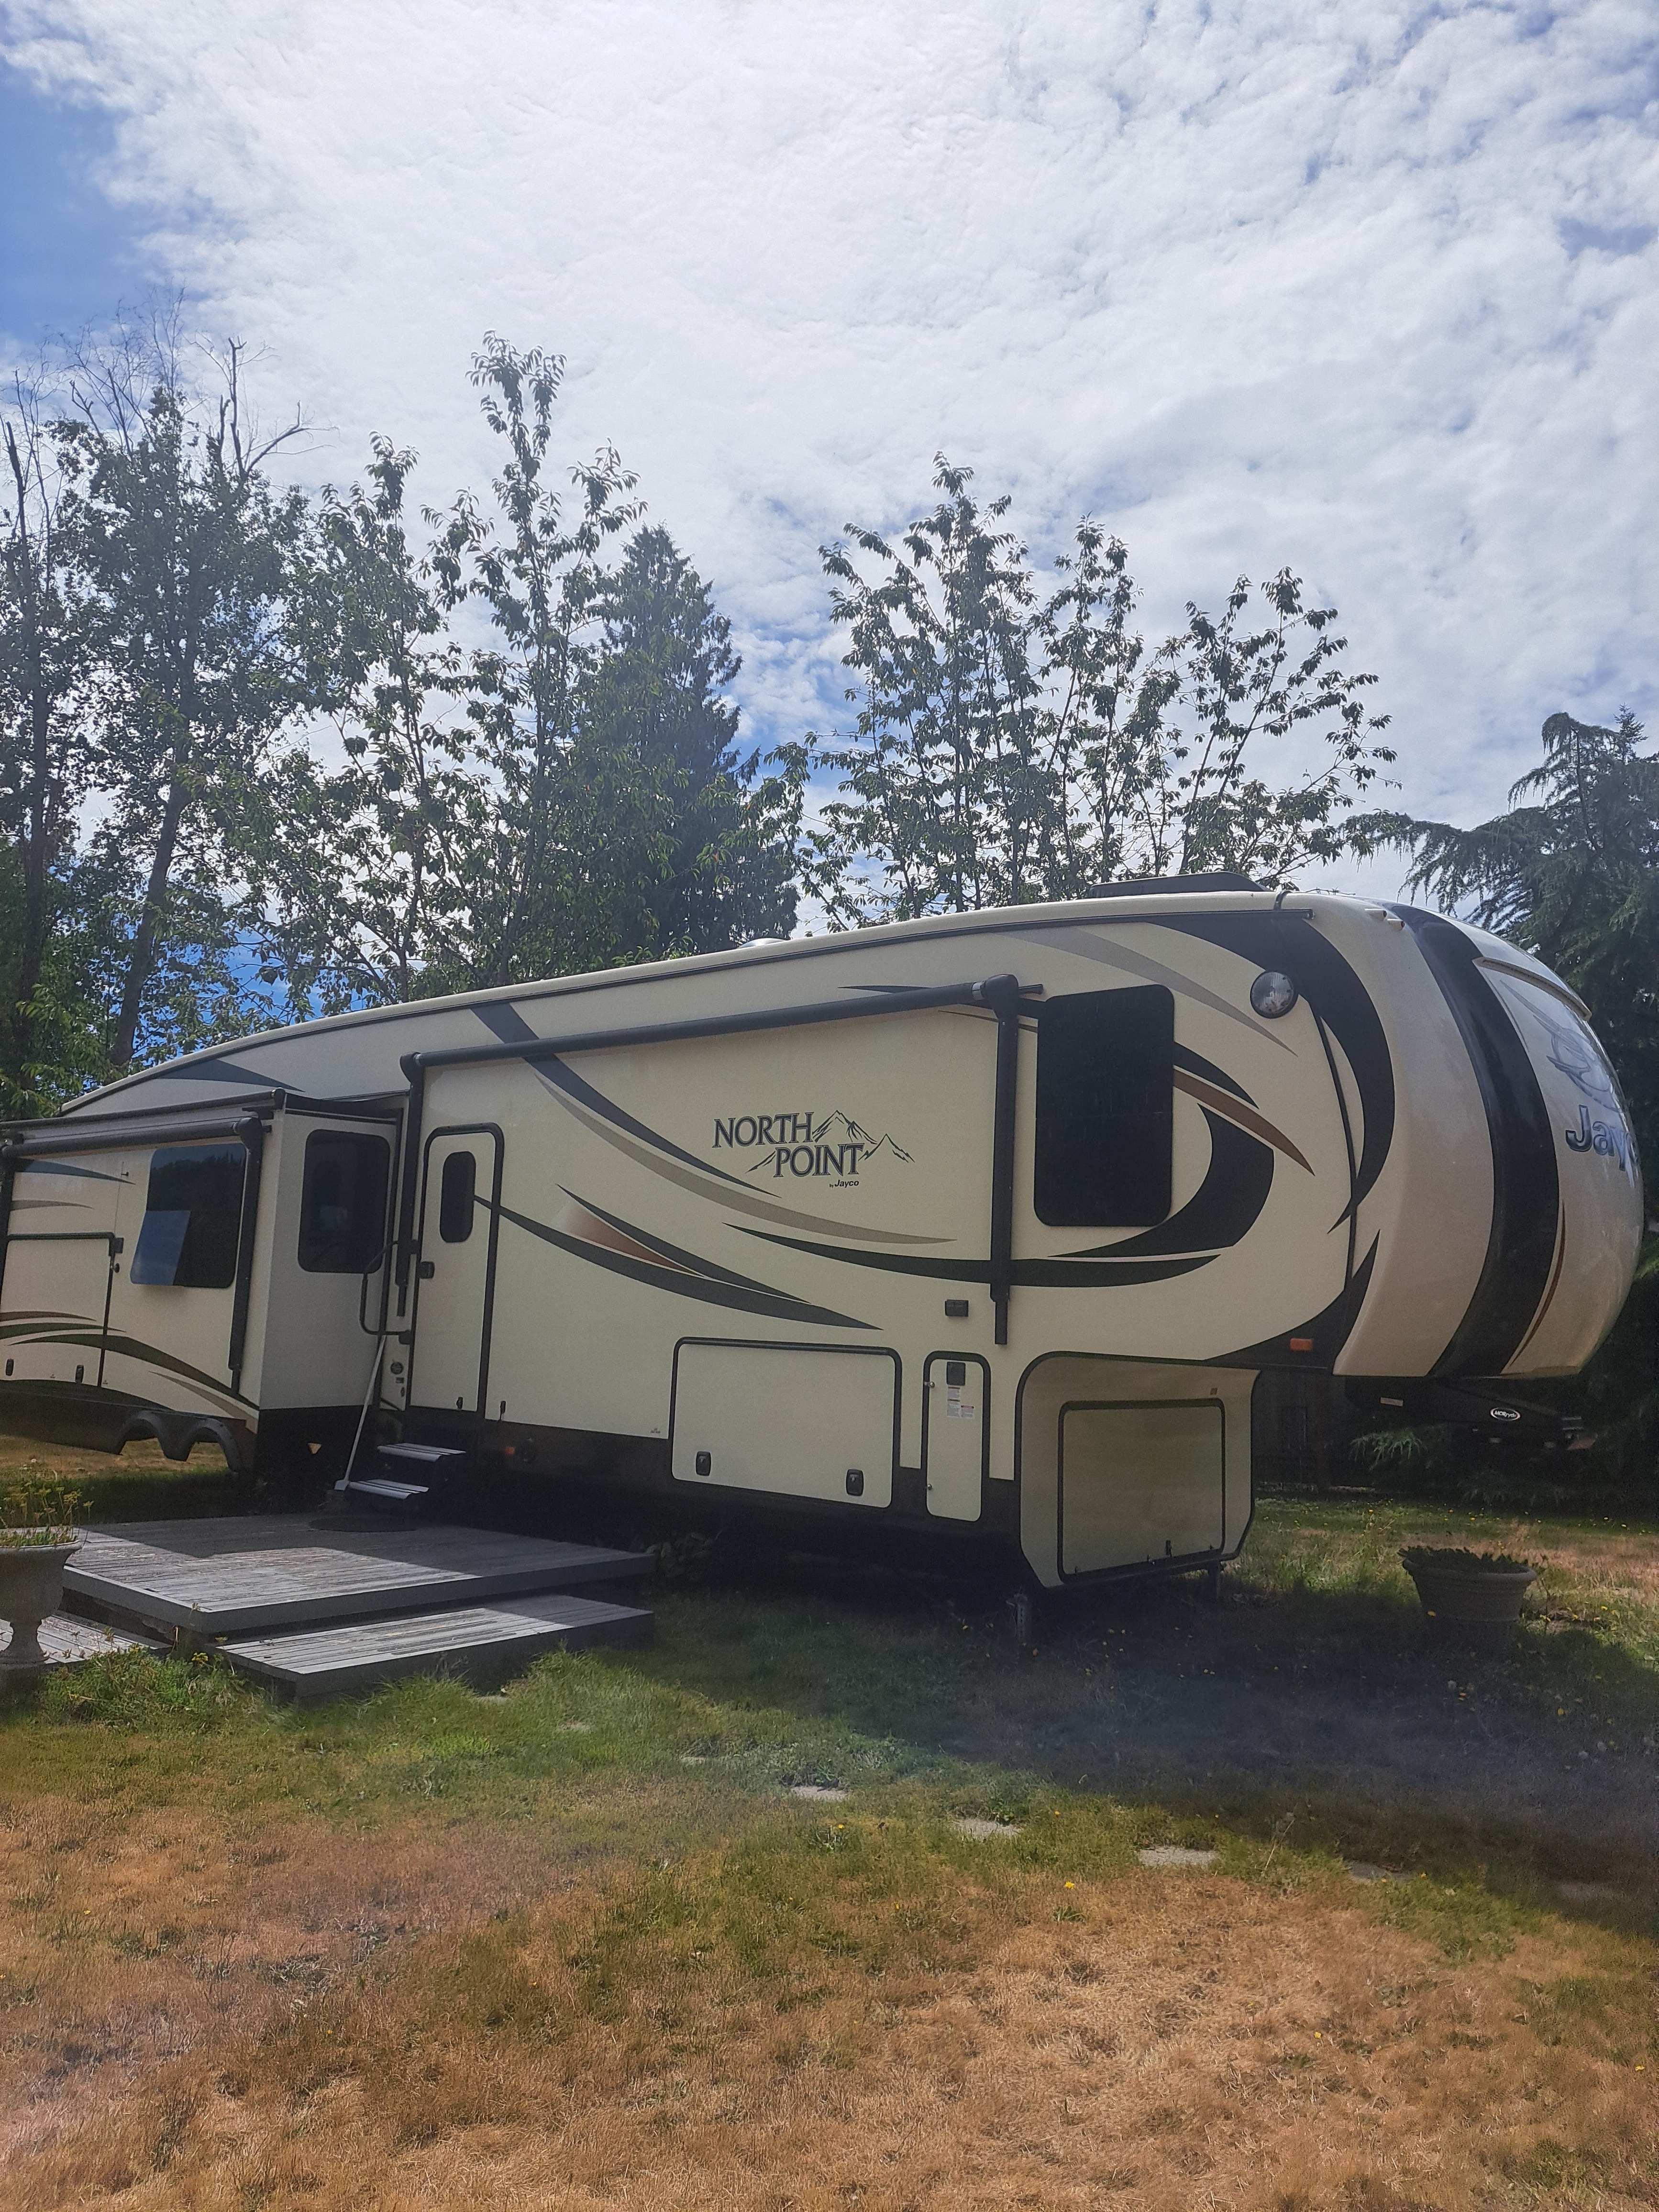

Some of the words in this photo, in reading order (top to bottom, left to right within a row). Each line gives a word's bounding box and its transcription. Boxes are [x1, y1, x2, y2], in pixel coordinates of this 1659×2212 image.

[712, 1112, 814, 1148] NORTH
[774, 1143, 864, 1177] POINT
[834, 1179, 859, 1188] Jayco
